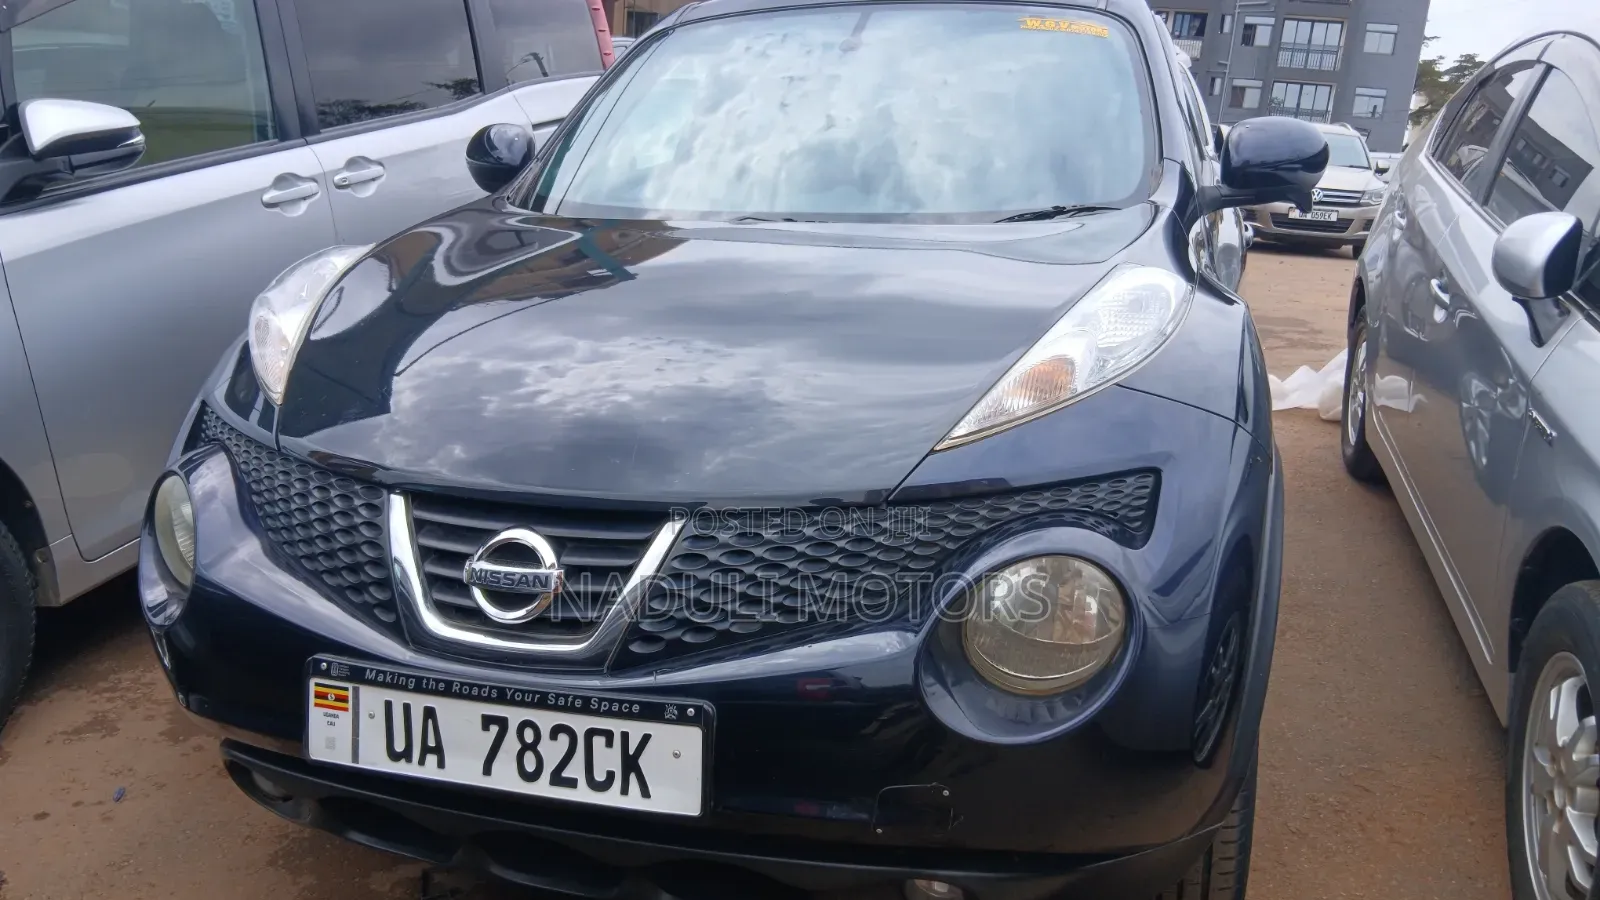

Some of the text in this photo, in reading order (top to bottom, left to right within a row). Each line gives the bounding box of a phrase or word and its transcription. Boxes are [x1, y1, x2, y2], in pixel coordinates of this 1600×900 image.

[470, 567, 549, 590] NISSAN
[365, 669, 416, 689] Making
[422, 679, 445, 691] the
[452, 682, 498, 698] Roads
[505, 688, 541, 703] Your
[547, 693, 582, 708] Safe
[590, 698, 640, 713] Space
[384, 699, 652, 799] UA 782CK
